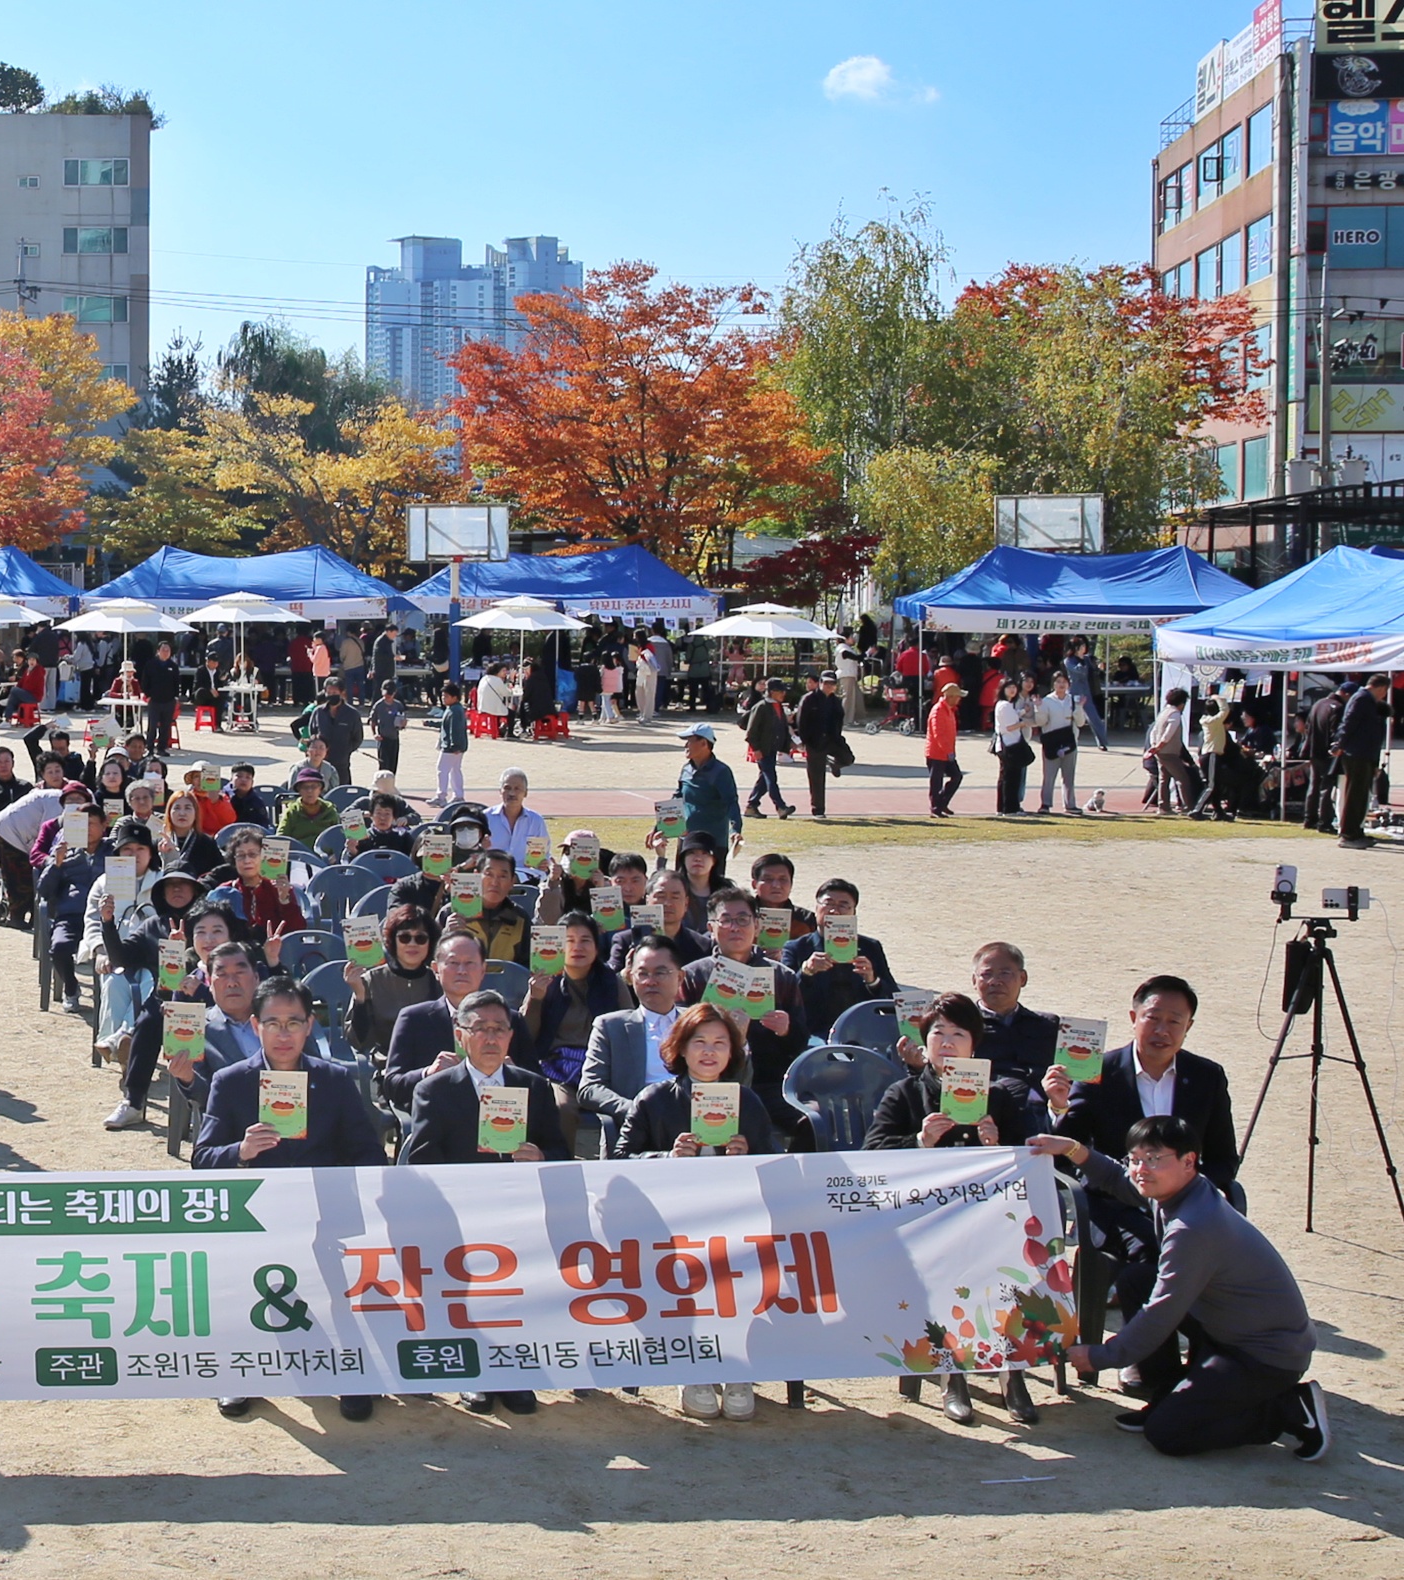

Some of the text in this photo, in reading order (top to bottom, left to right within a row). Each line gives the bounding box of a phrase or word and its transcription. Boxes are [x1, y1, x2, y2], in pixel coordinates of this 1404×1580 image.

[1197, 55, 1217, 115] 헬스
[1331, 121, 1385, 152] 음악
[1334, 230, 1380, 244] HERO
[996, 618, 1040, 630] 제12회
[1044, 619, 1081, 631] 대추골
[1085, 620, 1121, 631] 한마음
[1126, 619, 1150, 630] 축제
[826, 1175, 888, 1188] 2025 경기도
[907, 1183, 989, 1206] 육성지원
[993, 1180, 1027, 1200] 사업
[65, 1188, 170, 1224] 축제의
[181, 1188, 229, 1223] 장!
[31, 1250, 210, 1339] 축제
[250, 1264, 314, 1334] &
[344, 1243, 524, 1332] 작은
[559, 1231, 839, 1327] 영화제
[49, 1352, 104, 1381] 주관
[126, 1351, 220, 1379] 조원1동
[229, 1347, 365, 1378] 주민자치회
[410, 1341, 466, 1374] 후원
[488, 1341, 580, 1370] 조원1동
[587, 1335, 723, 1368] 단체협의회
